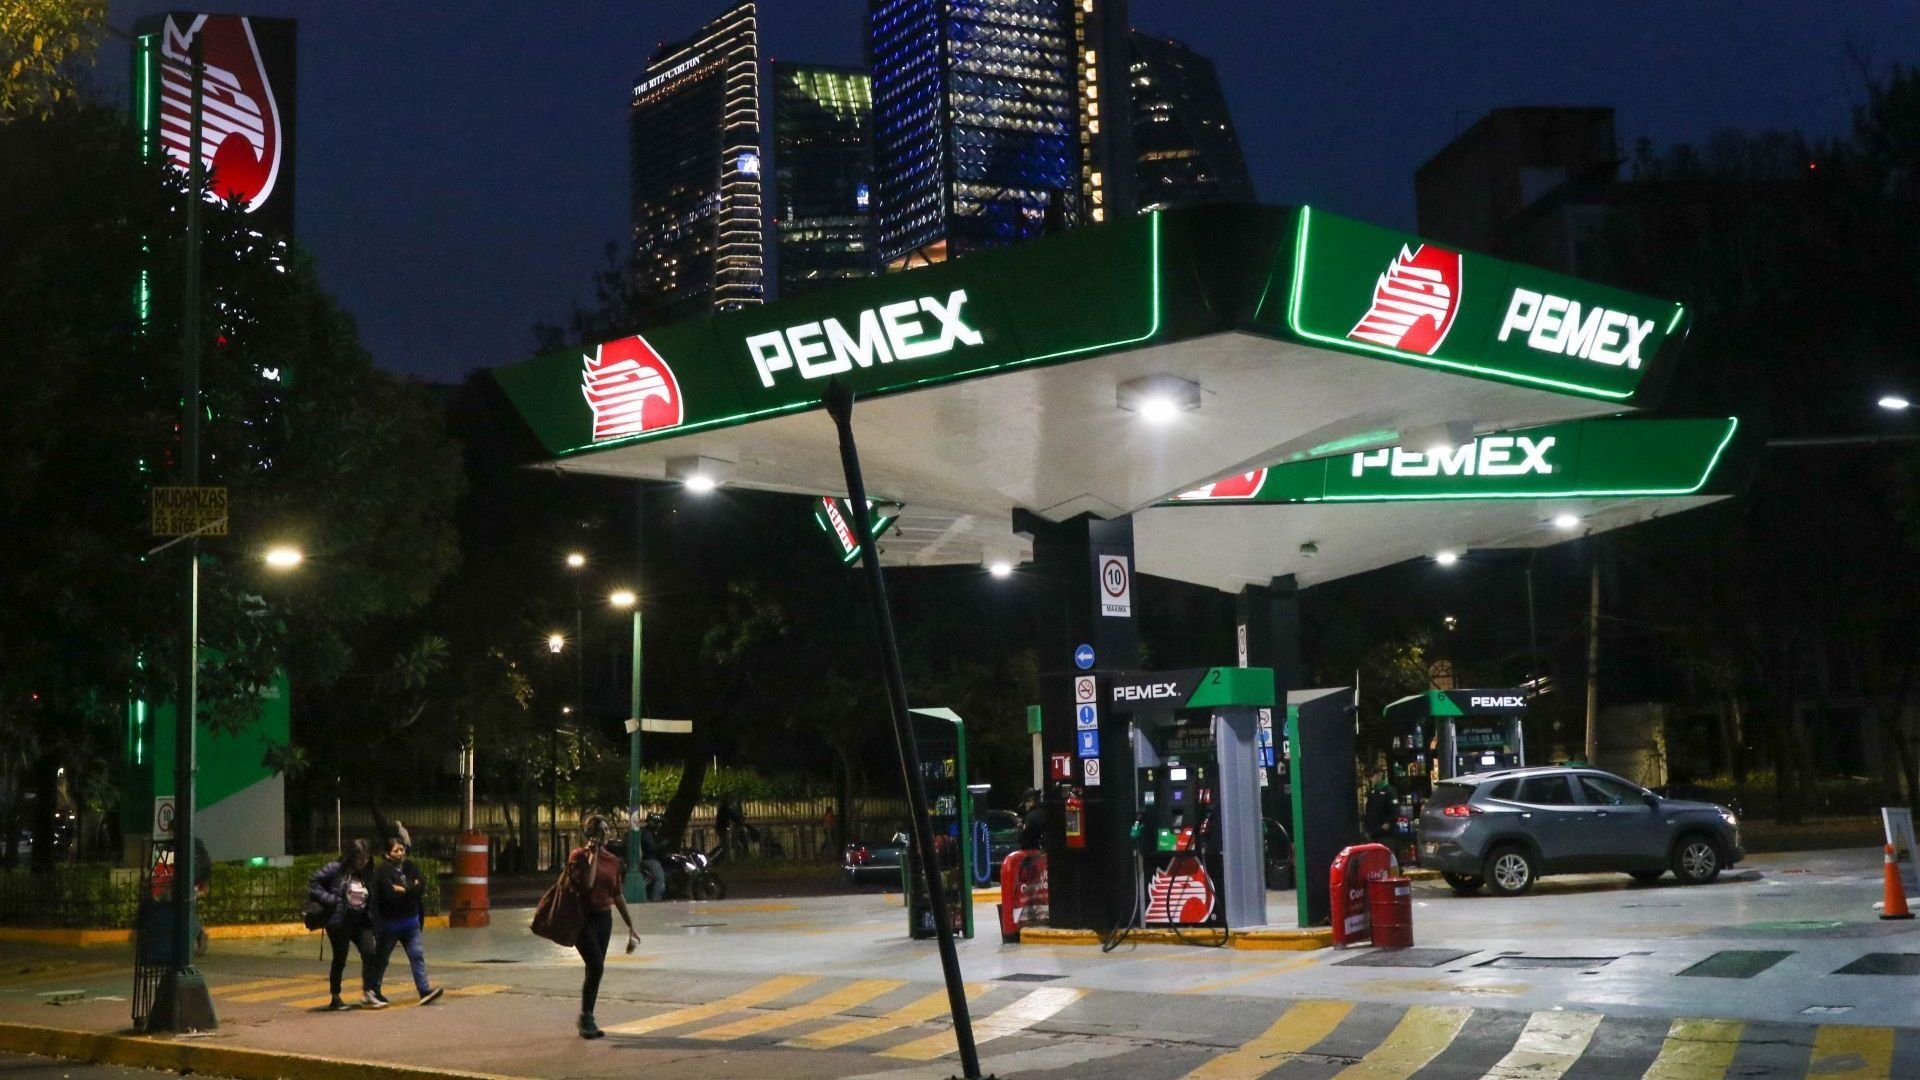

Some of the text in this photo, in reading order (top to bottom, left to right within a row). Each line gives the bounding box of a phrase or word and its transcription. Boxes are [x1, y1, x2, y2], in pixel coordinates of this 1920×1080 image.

[634, 83, 648, 96] THE
[1497, 287, 1654, 370] PEMEX
[746, 289, 984, 388] PEMEX
[1352, 436, 1555, 477] PEMEX
[154, 489, 226, 508] MUDANZAS
[1108, 569, 1121, 585] 10
[1212, 671, 1221, 685] 2
[1113, 682, 1177, 701] PEMEX
[1438, 693, 1445, 701] 6
[1471, 696, 1524, 707] PEMEX
[163, 810, 171, 822] 10
